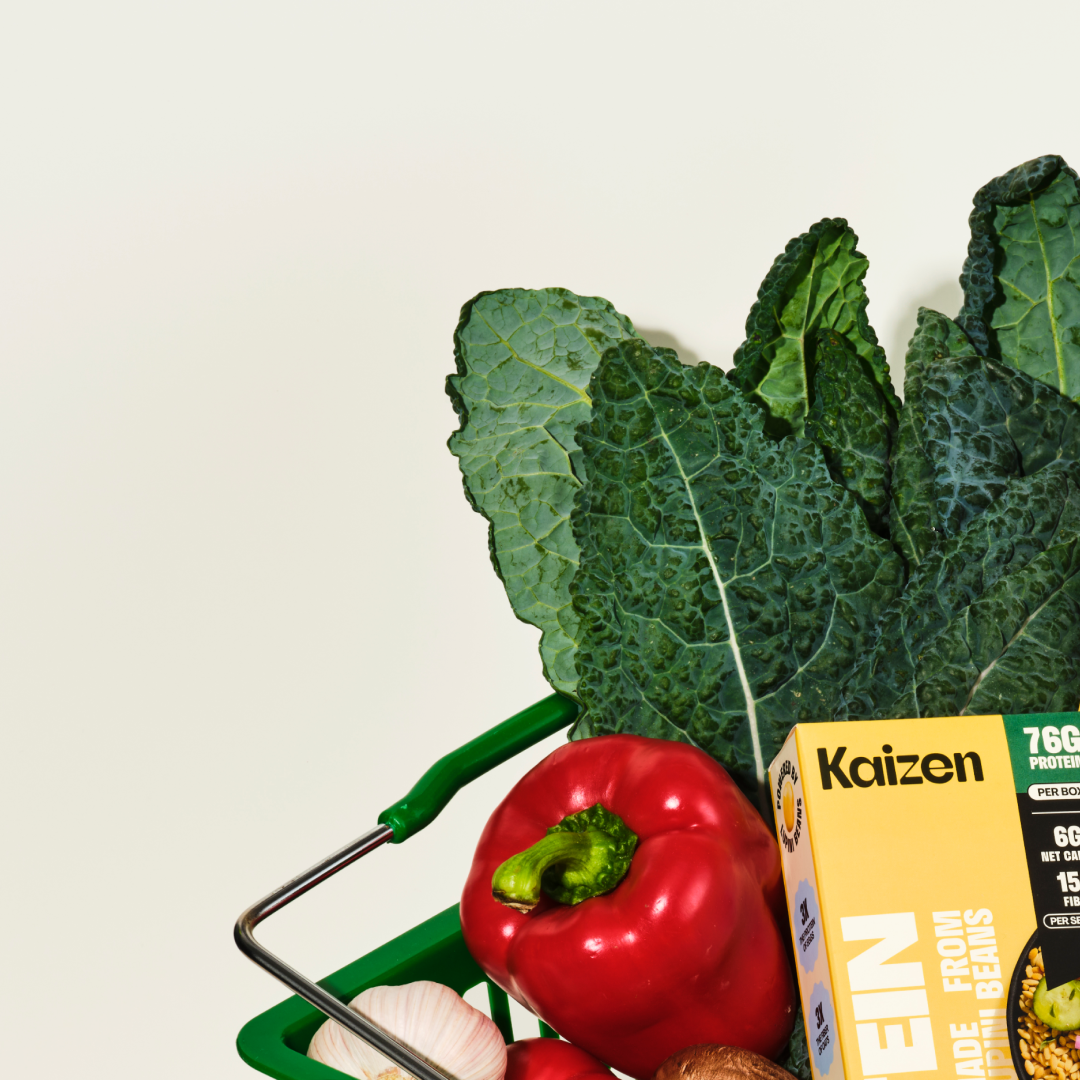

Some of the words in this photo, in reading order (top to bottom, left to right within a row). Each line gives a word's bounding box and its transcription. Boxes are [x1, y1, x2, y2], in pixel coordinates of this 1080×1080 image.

[776, 759, 791, 810] POWERED
[790, 764, 799, 785] BY
[817, 743, 984, 790] Kaizen
[1037, 787, 1059, 797] PER
[793, 797, 802, 846] BEANS
[1040, 851, 1061, 862] NET
[800, 897, 810, 926] 3X
[1049, 916, 1070, 926] PER
[932, 910, 968, 992] FROM
[963, 907, 1004, 998] BEANS
[815, 1001, 825, 1030] 3X
